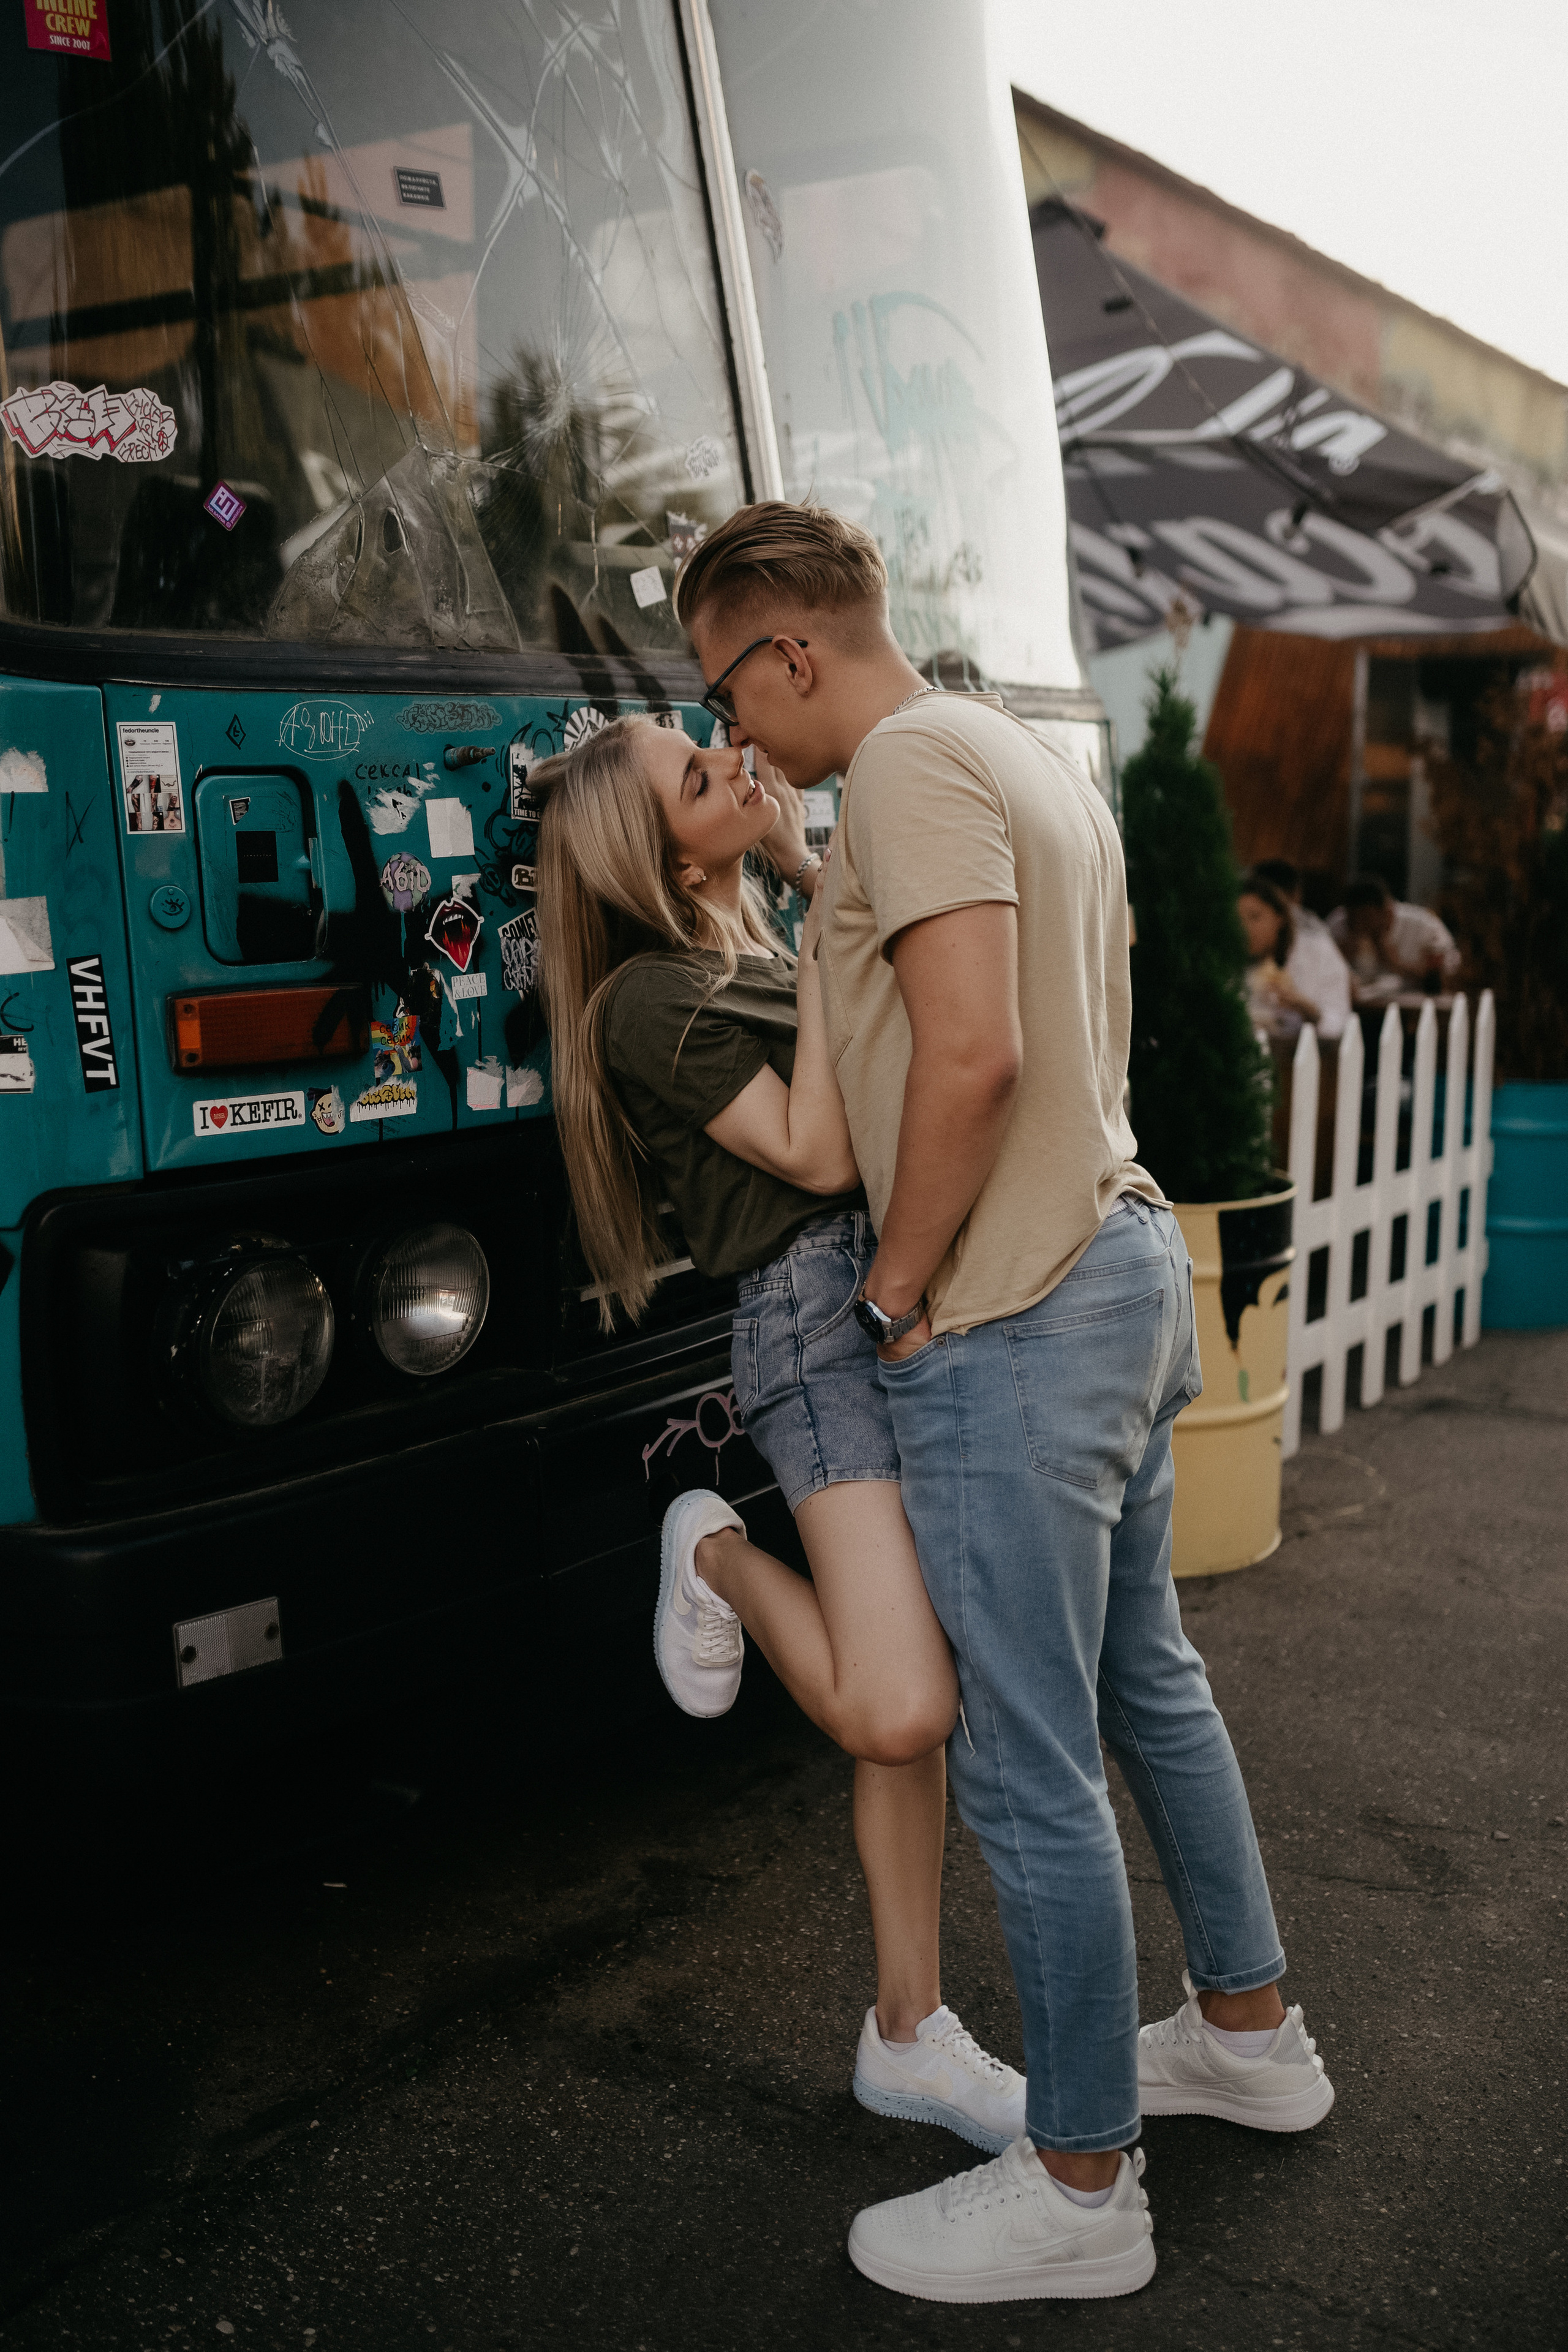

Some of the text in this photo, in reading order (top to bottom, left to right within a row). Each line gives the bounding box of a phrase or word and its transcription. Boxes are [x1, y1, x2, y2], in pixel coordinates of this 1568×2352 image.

[36, 0, 98, 20] INE
[45, 13, 91, 37] CREW
[50, 34, 91, 50] SINCE 2007
[514, 808, 528, 817] TIME
[453, 974, 485, 987] PEACE
[70, 957, 116, 1085] VHFVT
[200, 1107, 209, 1129] I
